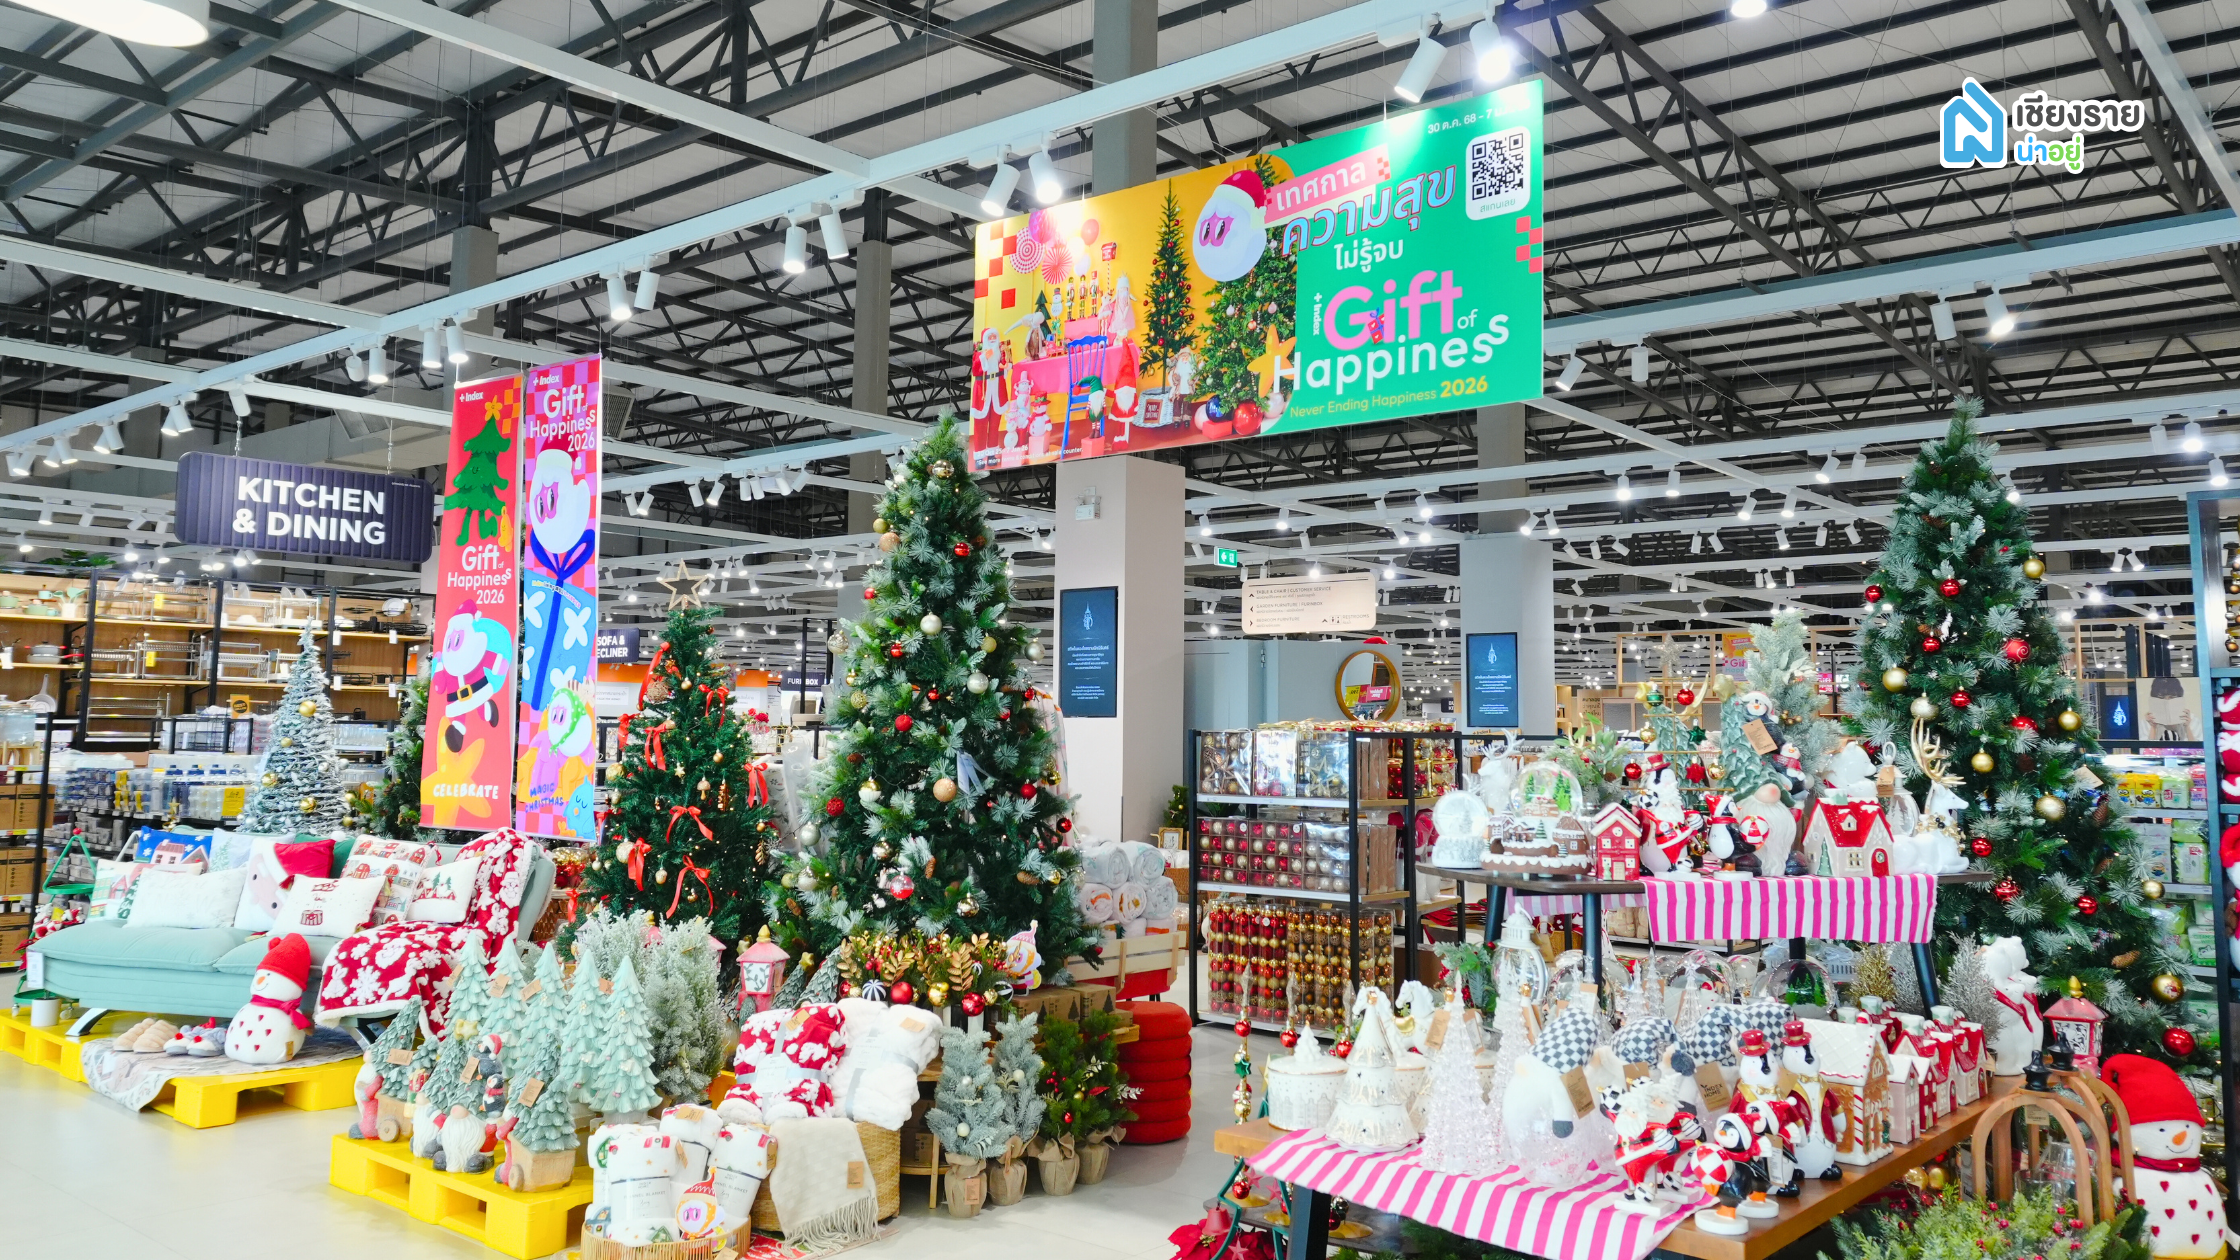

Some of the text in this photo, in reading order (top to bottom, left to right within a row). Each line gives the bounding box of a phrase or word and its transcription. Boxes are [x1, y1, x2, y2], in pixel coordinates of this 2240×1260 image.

[1427, 122, 1440, 134] 30
[1463, 113, 1477, 125] 68
[1485, 109, 1493, 119] 7
[1276, 160, 1367, 212] เทศกาล
[1281, 164, 1457, 258] ความสุข
[1479, 198, 1516, 213] สแกนเลย
[1333, 237, 1404, 273] ไม่รู้จบ
[1312, 304, 1323, 336] Index
[1322, 269, 1479, 351] Gift of
[1272, 313, 1511, 396] Happiness
[539, 374, 560, 385] Index
[465, 390, 484, 402] Index
[543, 384, 585, 419] Gift
[1289, 375, 1489, 418] Never Ending Happiness 2026
[529, 408, 596, 441] Happiness
[567, 431, 596, 452] 2026
[237, 475, 386, 515] KITCHEN
[232, 508, 386, 545] & DINING
[461, 543, 500, 572] Gift
[446, 567, 512, 591] Happiness
[475, 588, 505, 605] 2026
[597, 634, 626, 647] SOFA &
[597, 646, 629, 659] ECLINER
[433, 783, 499, 800] CELEBRATE
[529, 782, 556, 797] MAGIC
[524, 797, 565, 813] CHRISTMAS
